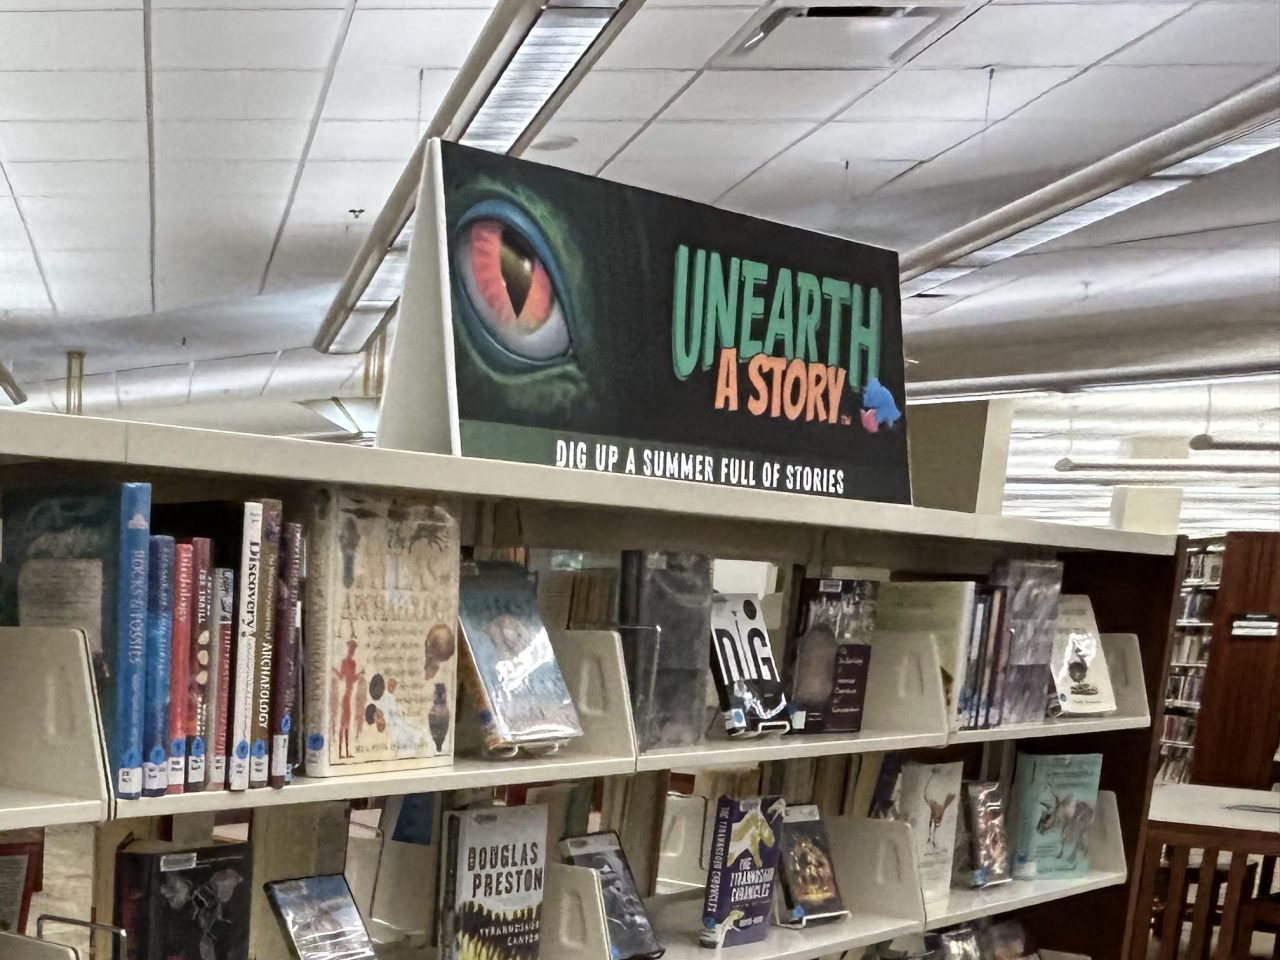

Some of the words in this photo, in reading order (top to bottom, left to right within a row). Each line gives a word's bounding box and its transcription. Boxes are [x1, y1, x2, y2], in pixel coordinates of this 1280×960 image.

[672, 244, 882, 391] UNEARTH
[715, 348, 738, 410] A
[747, 354, 846, 424] STORY
[556, 440, 587, 469] DIG
[596, 444, 618, 474] UP
[625, 447, 637, 475] A
[643, 449, 714, 481] SUMMER
[721, 457, 756, 487] FULL
[762, 461, 780, 488] OF
[786, 464, 845, 494] STORIES
[257, 642, 274, 729] ARCHAEOLOGY
[714, 619, 781, 686] DIG
[467, 841, 539, 872] DOUGLAS
[471, 867, 543, 899] PRESTON
